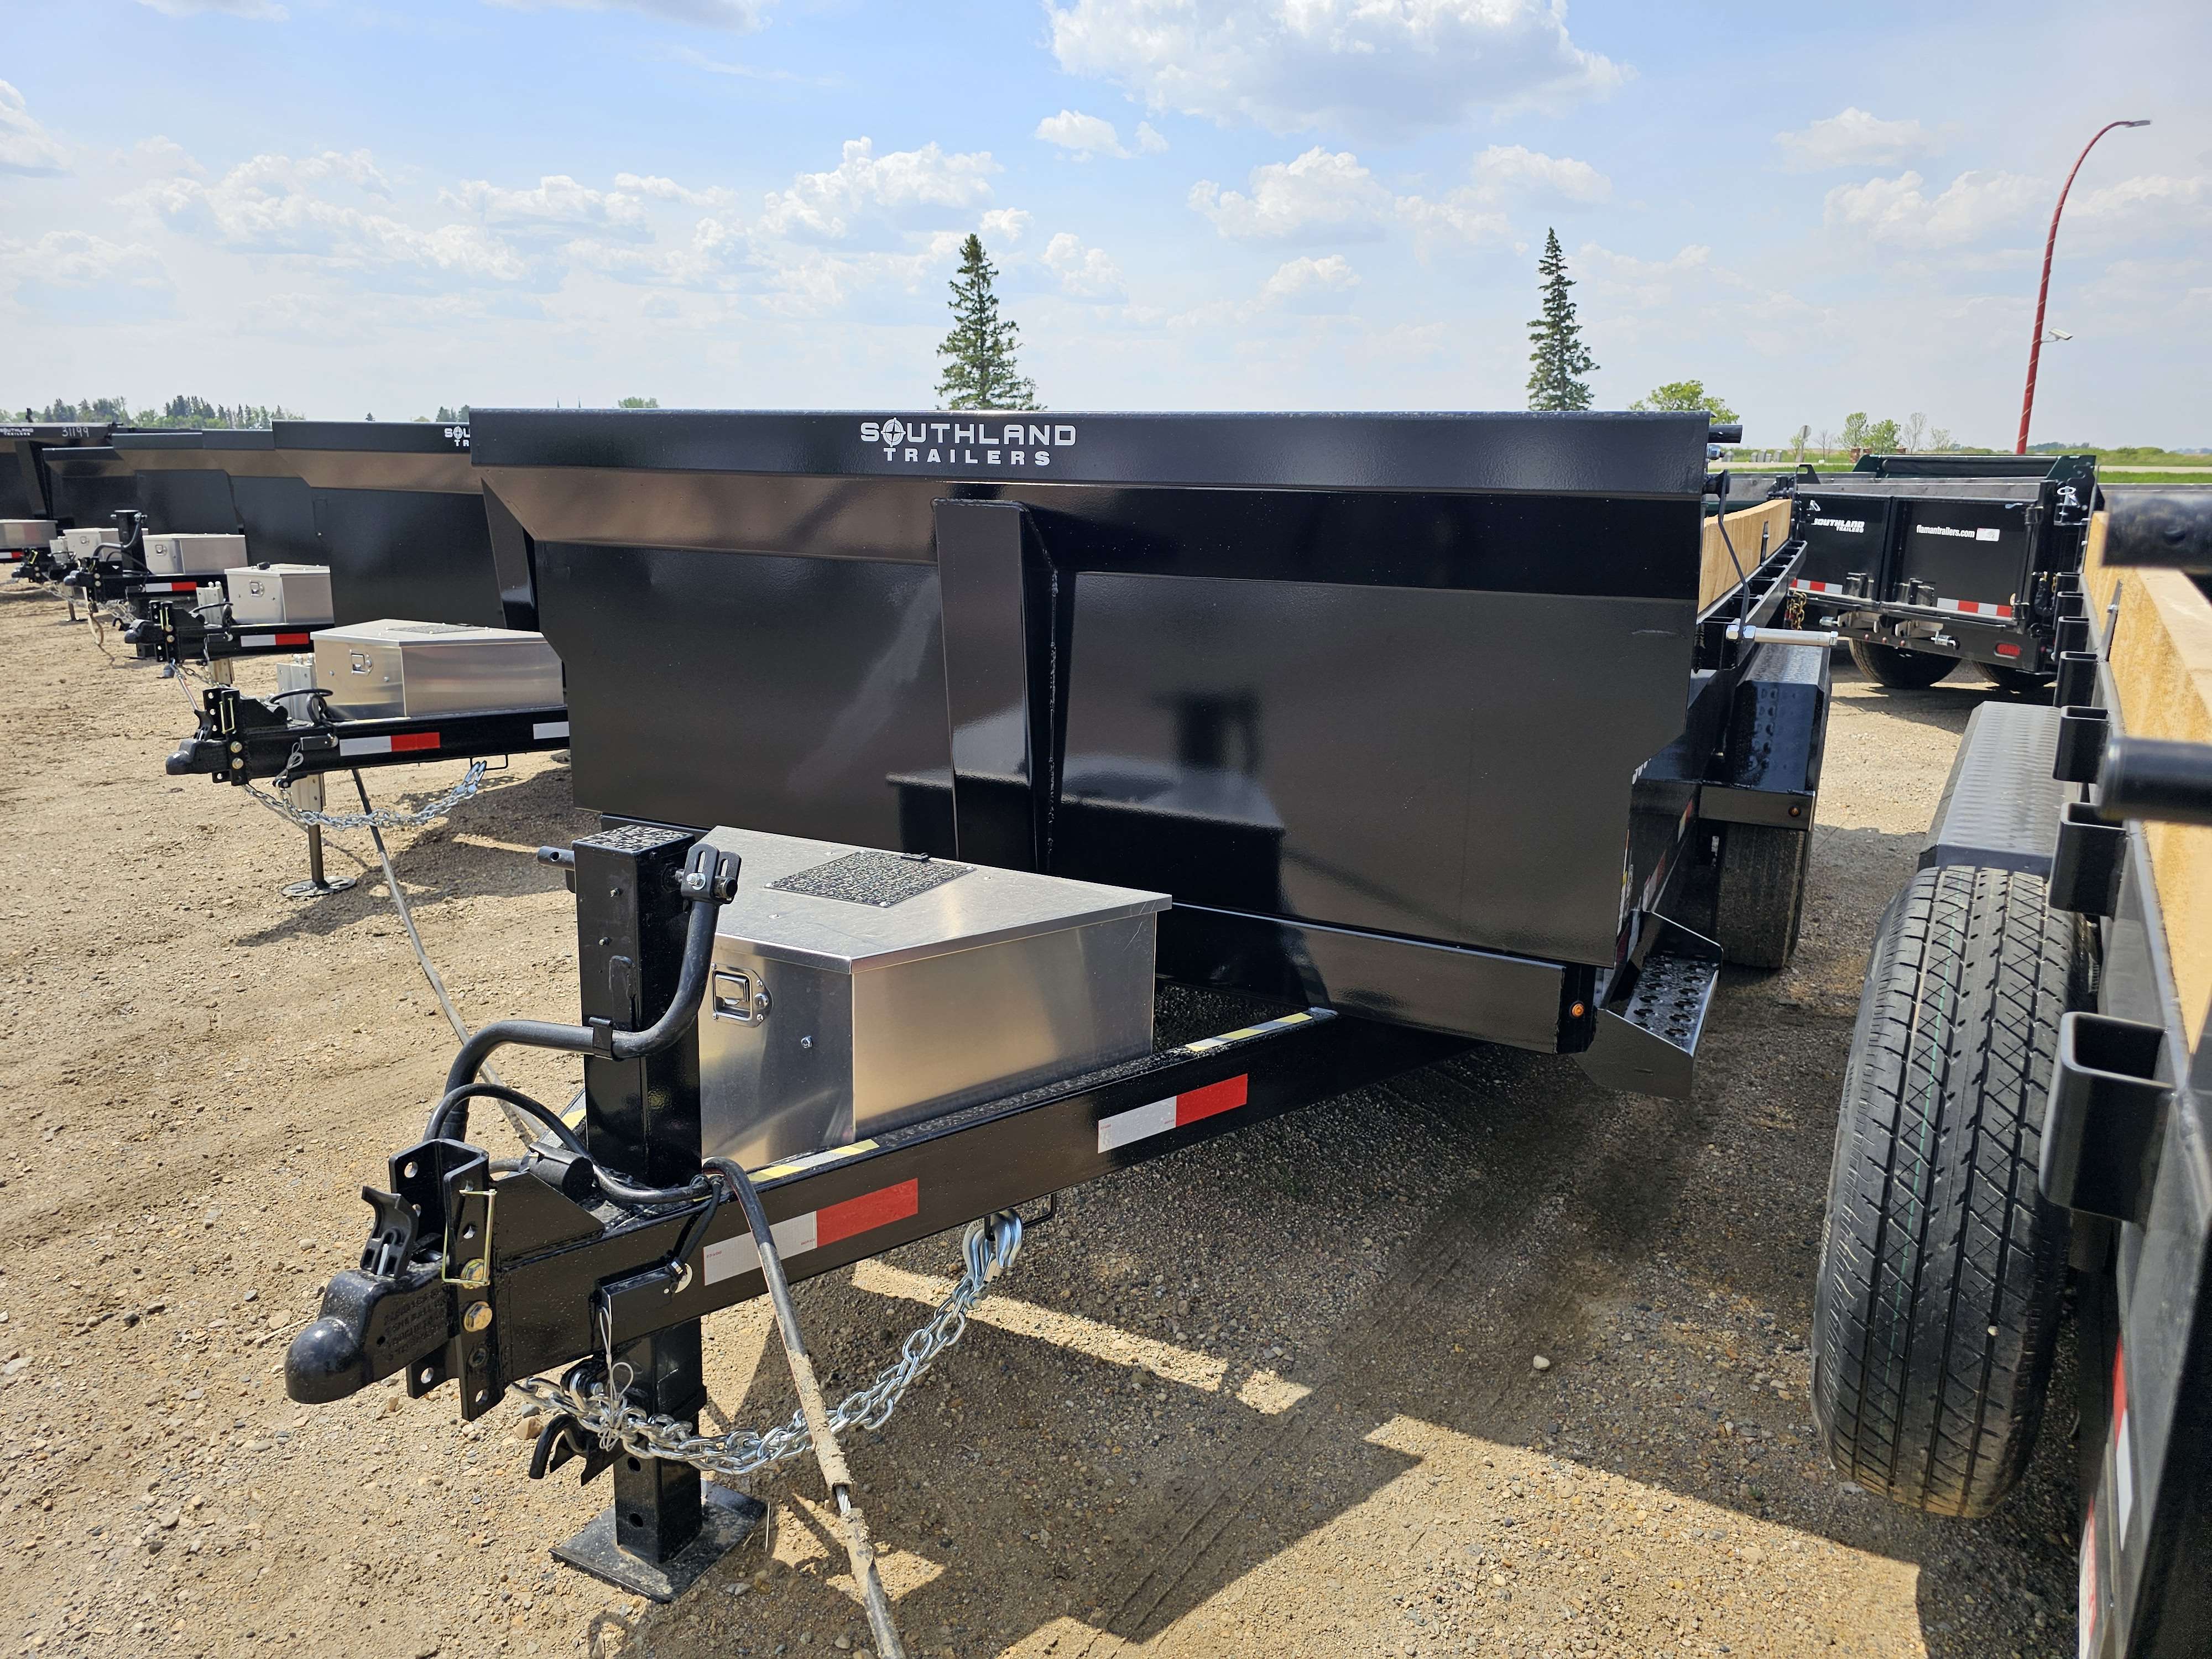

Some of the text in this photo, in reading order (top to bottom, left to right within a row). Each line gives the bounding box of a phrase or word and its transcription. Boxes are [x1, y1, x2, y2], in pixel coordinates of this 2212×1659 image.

[62, 426, 89, 437] 31199
[860, 418, 1077, 447] SOUTHLAND
[883, 447, 1051, 466] TRAILERS
[1812, 518, 1865, 528] SOUTHLAND
[1916, 525, 1975, 538] flamantrailers.com
